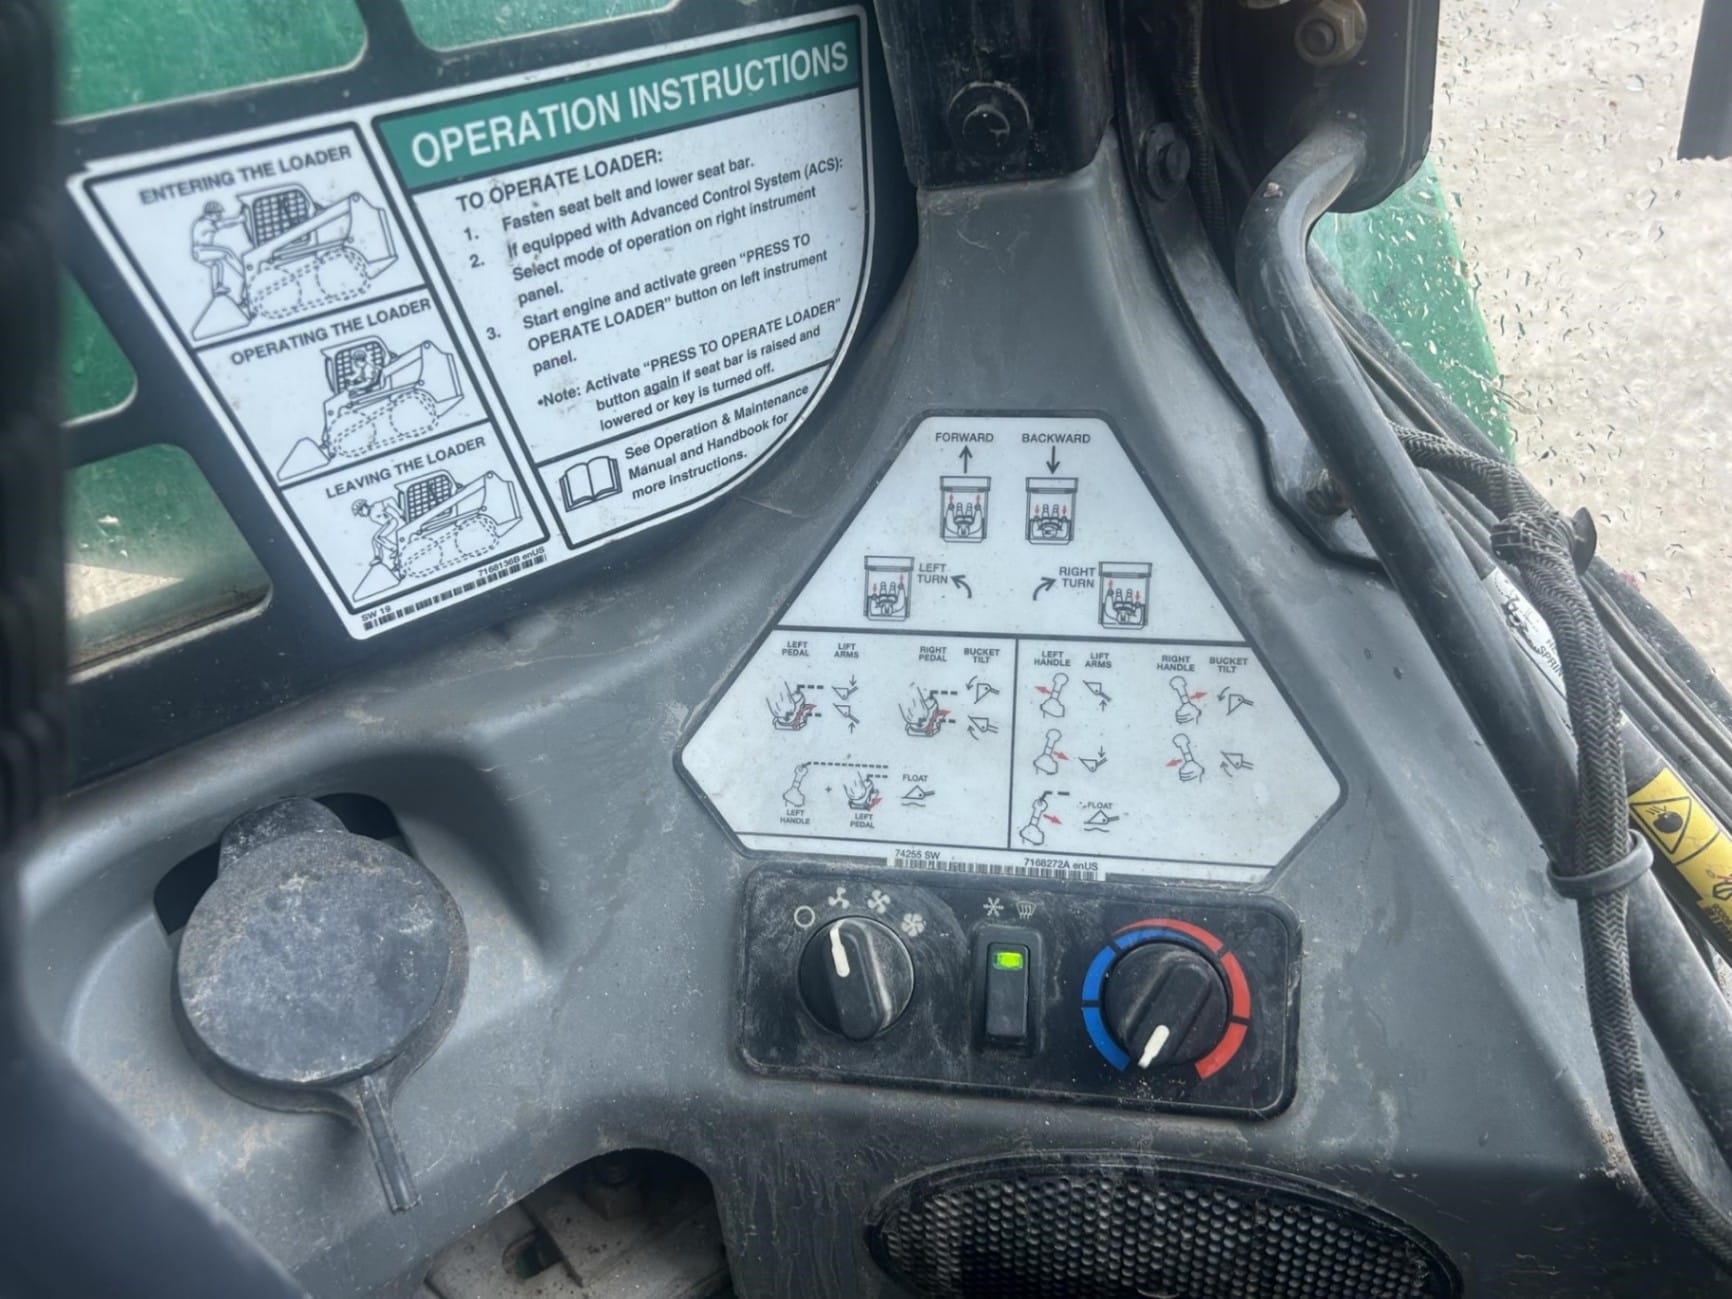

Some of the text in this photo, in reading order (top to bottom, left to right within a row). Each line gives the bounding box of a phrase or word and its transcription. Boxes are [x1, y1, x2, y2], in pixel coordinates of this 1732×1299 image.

[413, 41, 848, 167] OPERATION INSTRUCTIONS
[140, 145, 352, 205] ENTERING THE LOADER
[456, 149, 662, 212] TO OPERATE LOADER:
[463, 155, 754, 242] 1. Fasten seat belt and lower seat bar.
[470, 156, 844, 268] 2. If equipped with Advanced Control System (ACS):
[512, 186, 817, 282] Select mode of operation on right instrument
[486, 327, 501, 340] 3.
[523, 310, 560, 330] Start
[562, 296, 611, 320] engine
[614, 285, 641, 302] and
[644, 267, 697, 295] activate
[699, 252, 737, 279] green
[793, 232, 811, 247] TO
[518, 282, 564, 308] panel.
[527, 320, 602, 352] OPERATE
[674, 286, 718, 307] button
[721, 280, 738, 295] on
[740, 269, 760, 287] left
[763, 250, 828, 280] instrument
[231, 298, 431, 366] OPERATING THE LOADER
[584, 364, 641, 395] Activate
[700, 338, 718, 355] TO
[721, 318, 783, 350] OPERATE
[533, 351, 578, 377] panel.
[595, 325, 821, 413] button again if seat bar is raised and
[600, 362, 774, 432] lowered or key is turned off.
[624, 384, 809, 460] See Operation & Maintenance
[935, 432, 994, 443] FORWARD
[1022, 433, 1091, 444] BACKWARD
[628, 410, 789, 481] Manual and Handbook for
[325, 437, 486, 498] LEAVING THE LOADER
[631, 448, 747, 501] more instructions.
[919, 563, 946, 573] LEFT
[1059, 566, 1096, 576] RIGHT
[917, 574, 948, 584] TURN
[1063, 578, 1095, 588] TURN
[361, 605, 391, 622] SW 19
[787, 641, 808, 649] LEFT
[838, 643, 856, 651] LIFT
[782, 648, 810, 657] PEDAL
[834, 651, 859, 659] ARMS
[920, 646, 946, 655] RIGHT
[964, 647, 1000, 656] BUCKET
[918, 654, 947, 662] PEDAL
[973, 656, 990, 664] TILT
[1090, 652, 1109, 660] LIFT
[1162, 655, 1190, 663] RIGHT
[1209, 656, 1248, 665] BUCKET
[1034, 658, 1071, 667] HANDLE
[1085, 660, 1112, 669] ARMS
[1157, 663, 1195, 672] HANDLE
[1217, 665, 1237, 673] TILT
[903, 774, 928, 782] FLOAT
[780, 817, 810, 825] HANDLE
[855, 813, 873, 821] LEFT
[850, 821, 875, 829] PEDAL
[924, 851, 940, 860] SW
